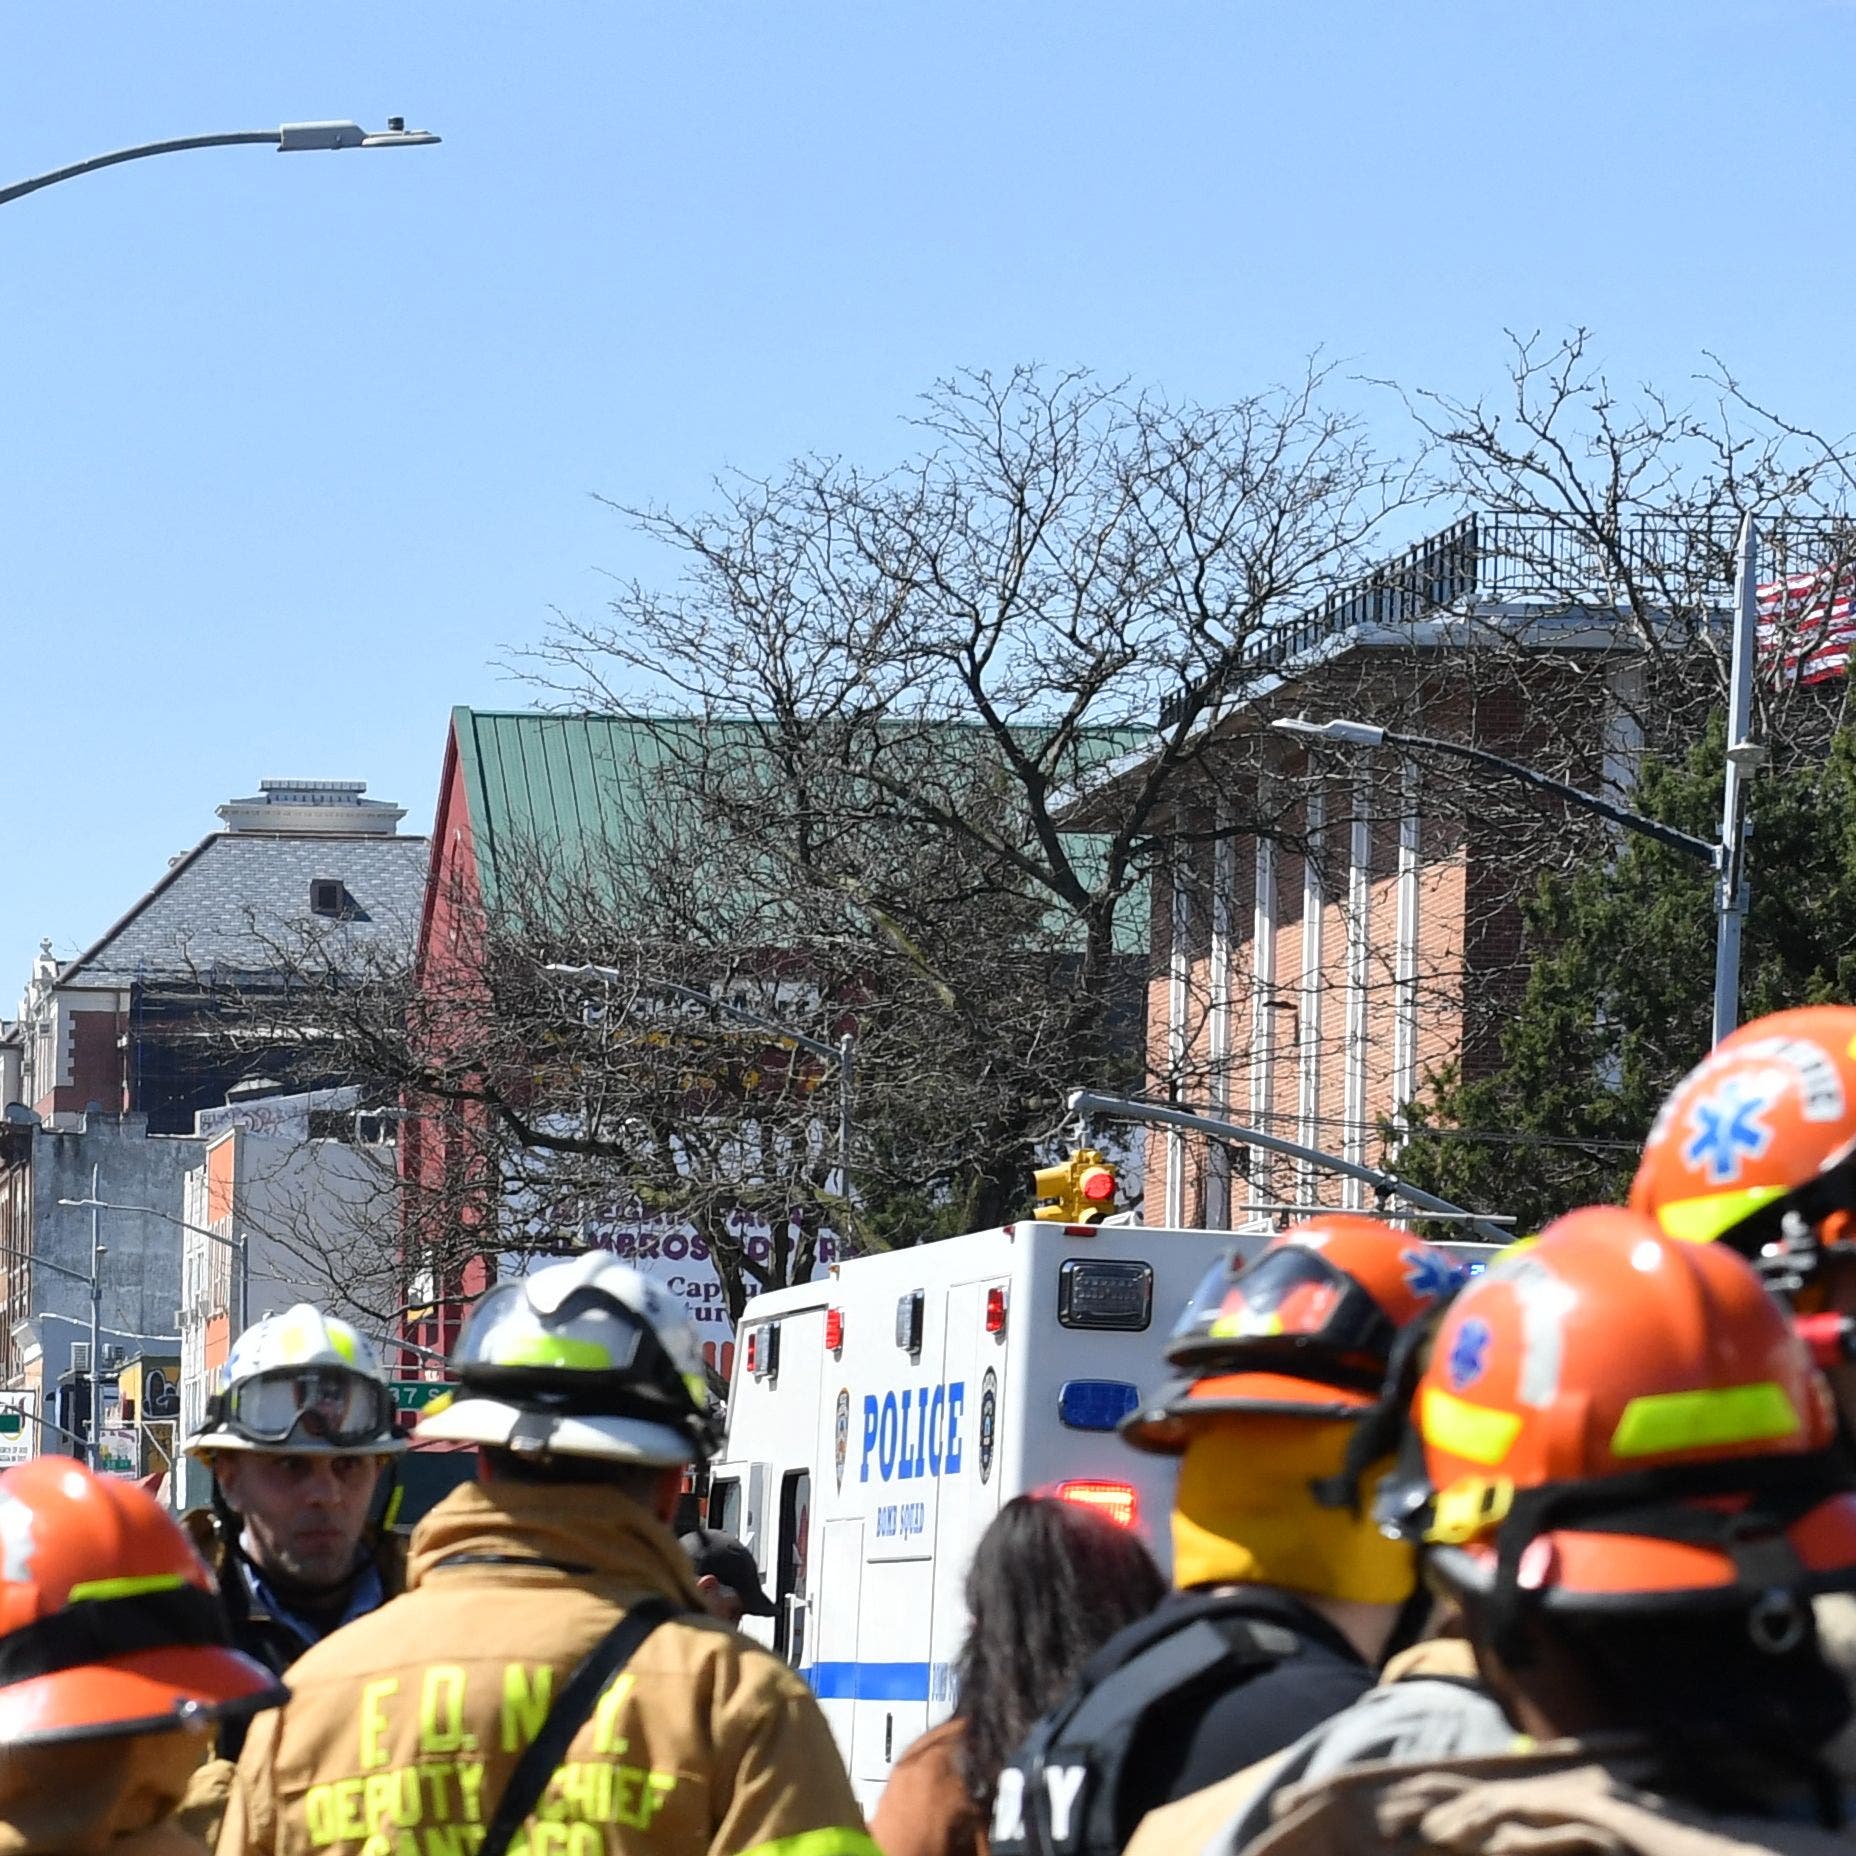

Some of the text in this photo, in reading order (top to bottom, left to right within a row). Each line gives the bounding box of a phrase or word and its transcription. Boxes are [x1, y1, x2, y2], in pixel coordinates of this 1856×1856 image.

[859, 1381, 965, 1484] POLICE
[899, 1502, 925, 1542] SQUAD
[305, 1761, 678, 1847] DEPUTY CHIEF
